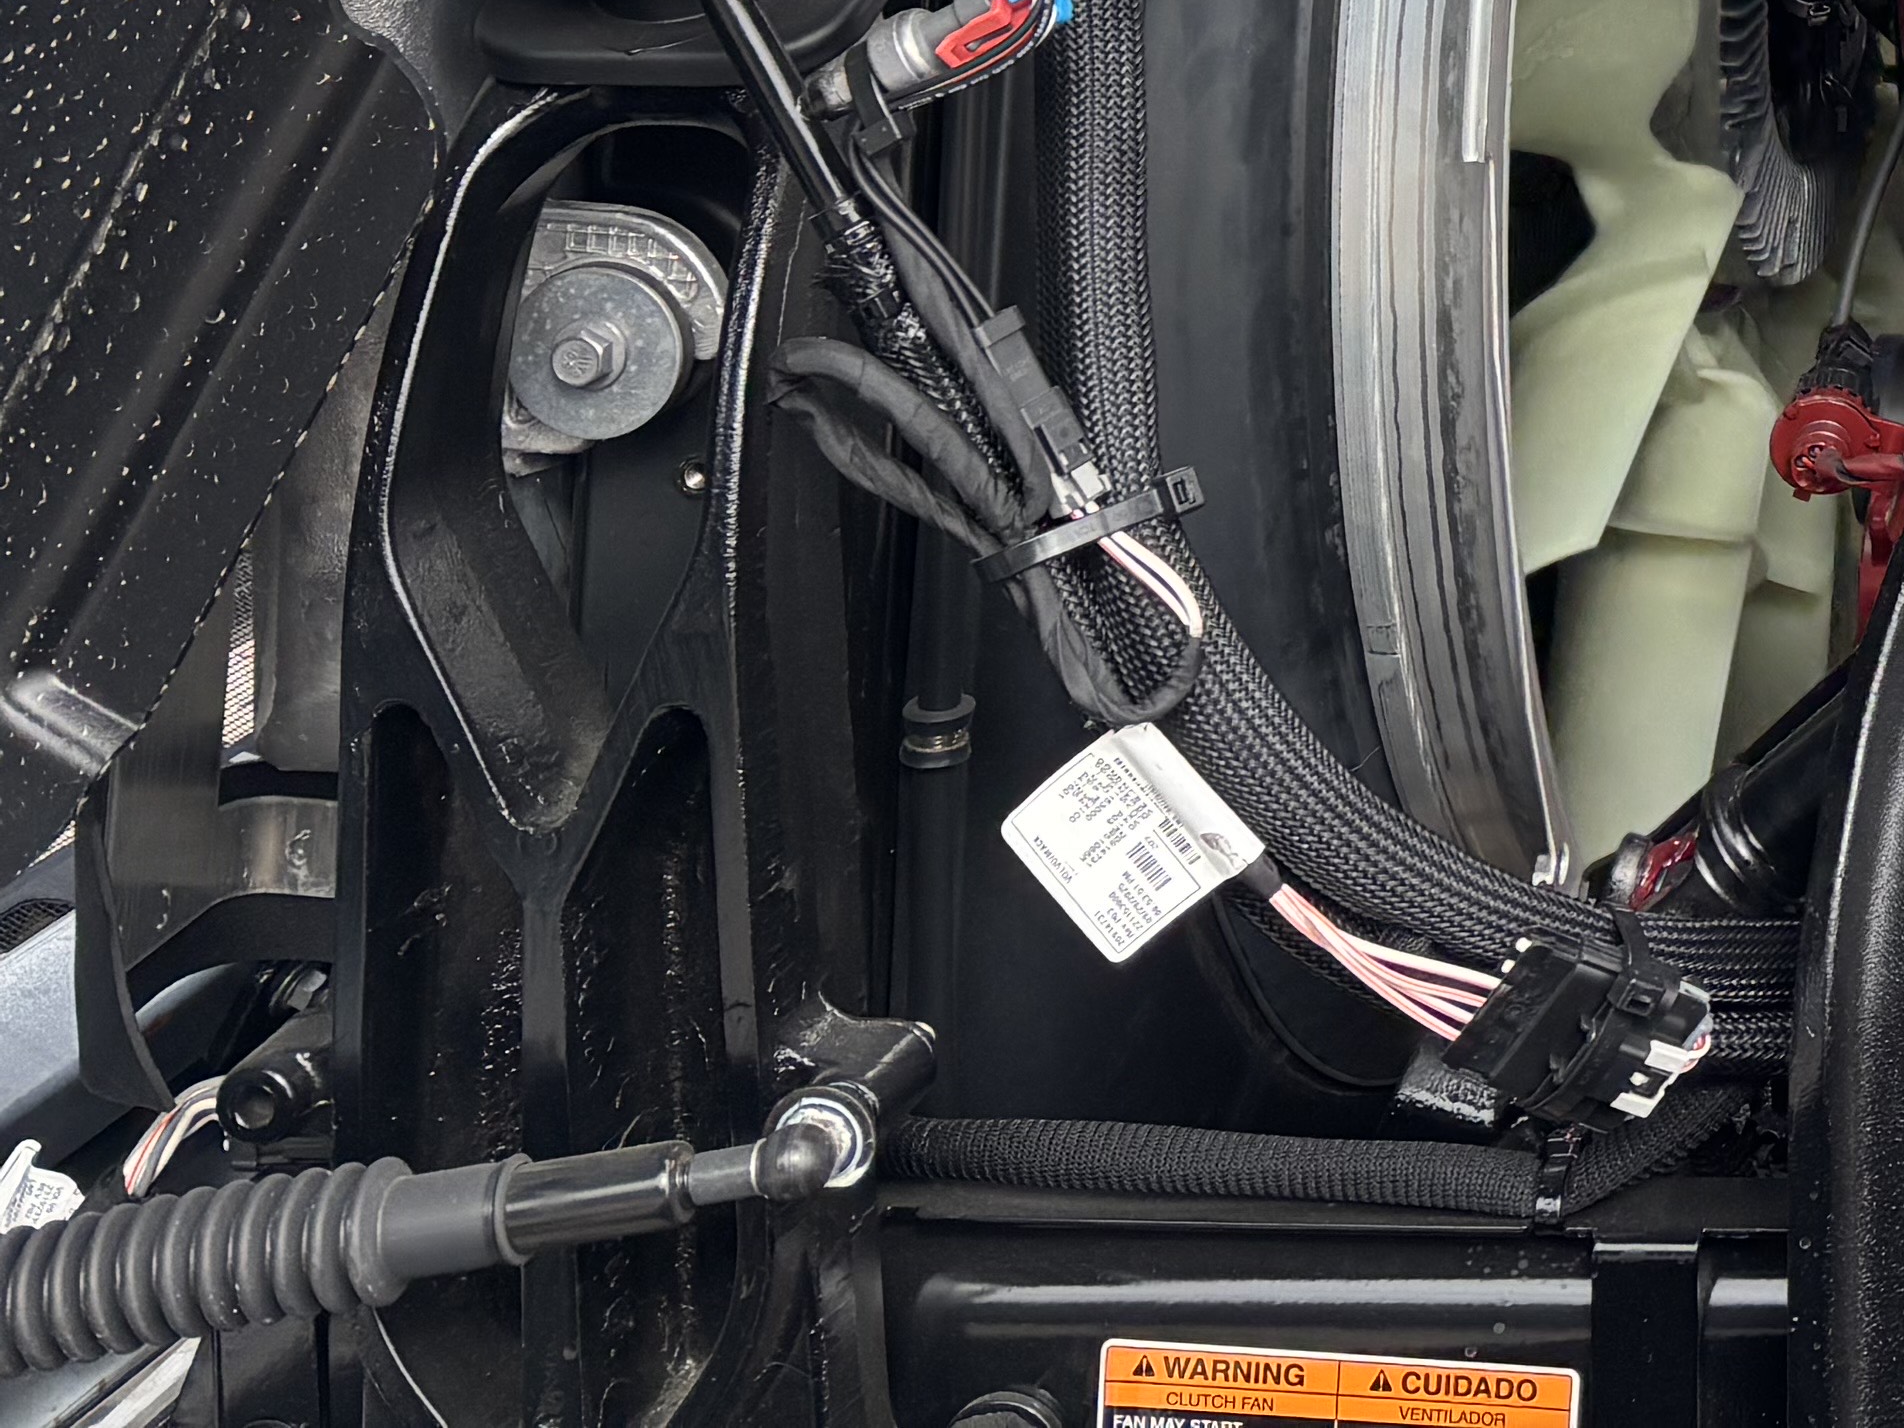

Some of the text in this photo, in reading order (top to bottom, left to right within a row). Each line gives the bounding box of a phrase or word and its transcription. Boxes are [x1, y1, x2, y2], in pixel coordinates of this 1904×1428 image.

[1163, 1355, 1306, 1388] WARNING
[1401, 1371, 1539, 1402] CUIDADO
[1166, 1392, 1274, 1411] CLUTCH FAN
[1113, 1415, 1148, 1428] FAN
[1150, 1417, 1186, 1428] MAY
[1398, 1406, 1506, 1426] VENTILADOR
